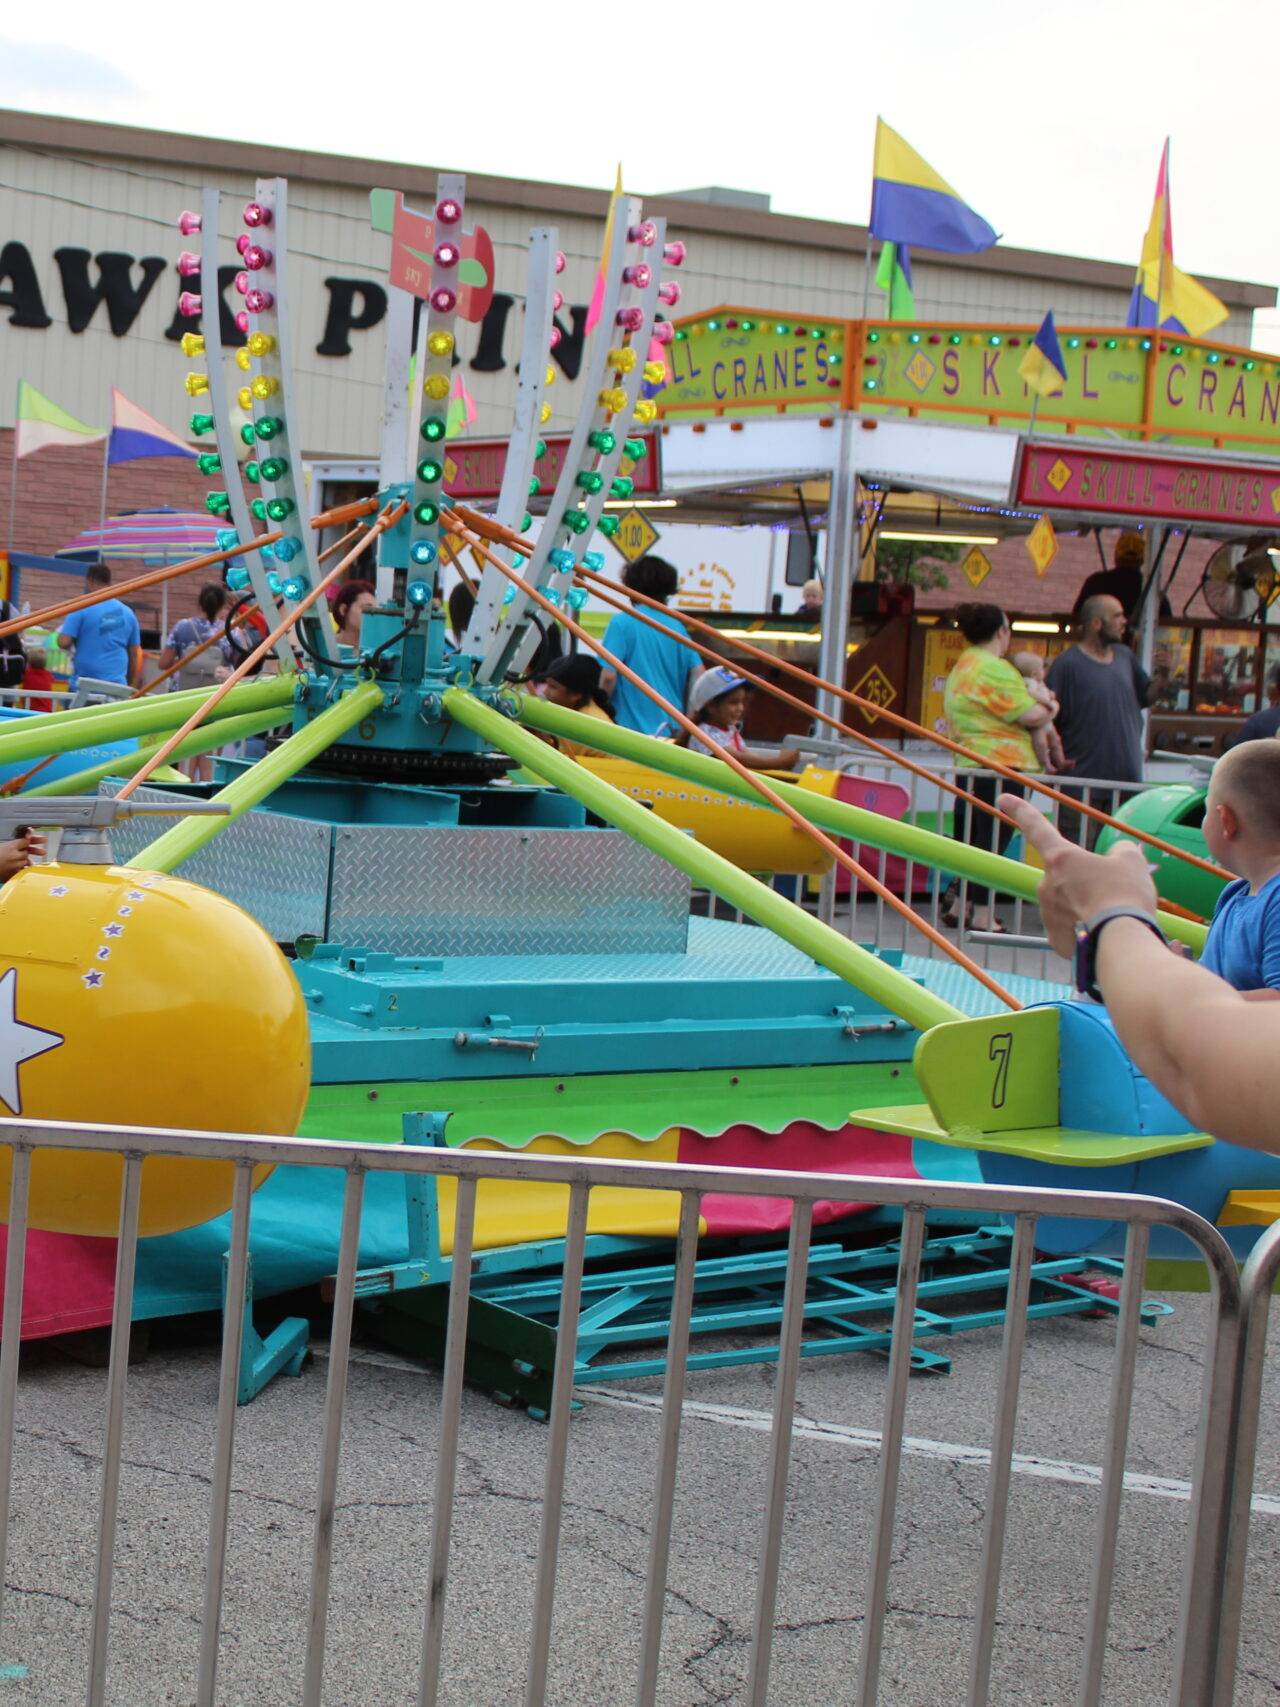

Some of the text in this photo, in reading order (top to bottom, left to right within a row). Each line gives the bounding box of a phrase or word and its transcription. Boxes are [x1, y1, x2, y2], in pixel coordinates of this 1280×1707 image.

[712, 342, 829, 400] CRANES
[942, 349, 1099, 400] SKL
[1079, 459, 1265, 516] SKILL CRANES
[988, 1031, 1014, 1110] 7
